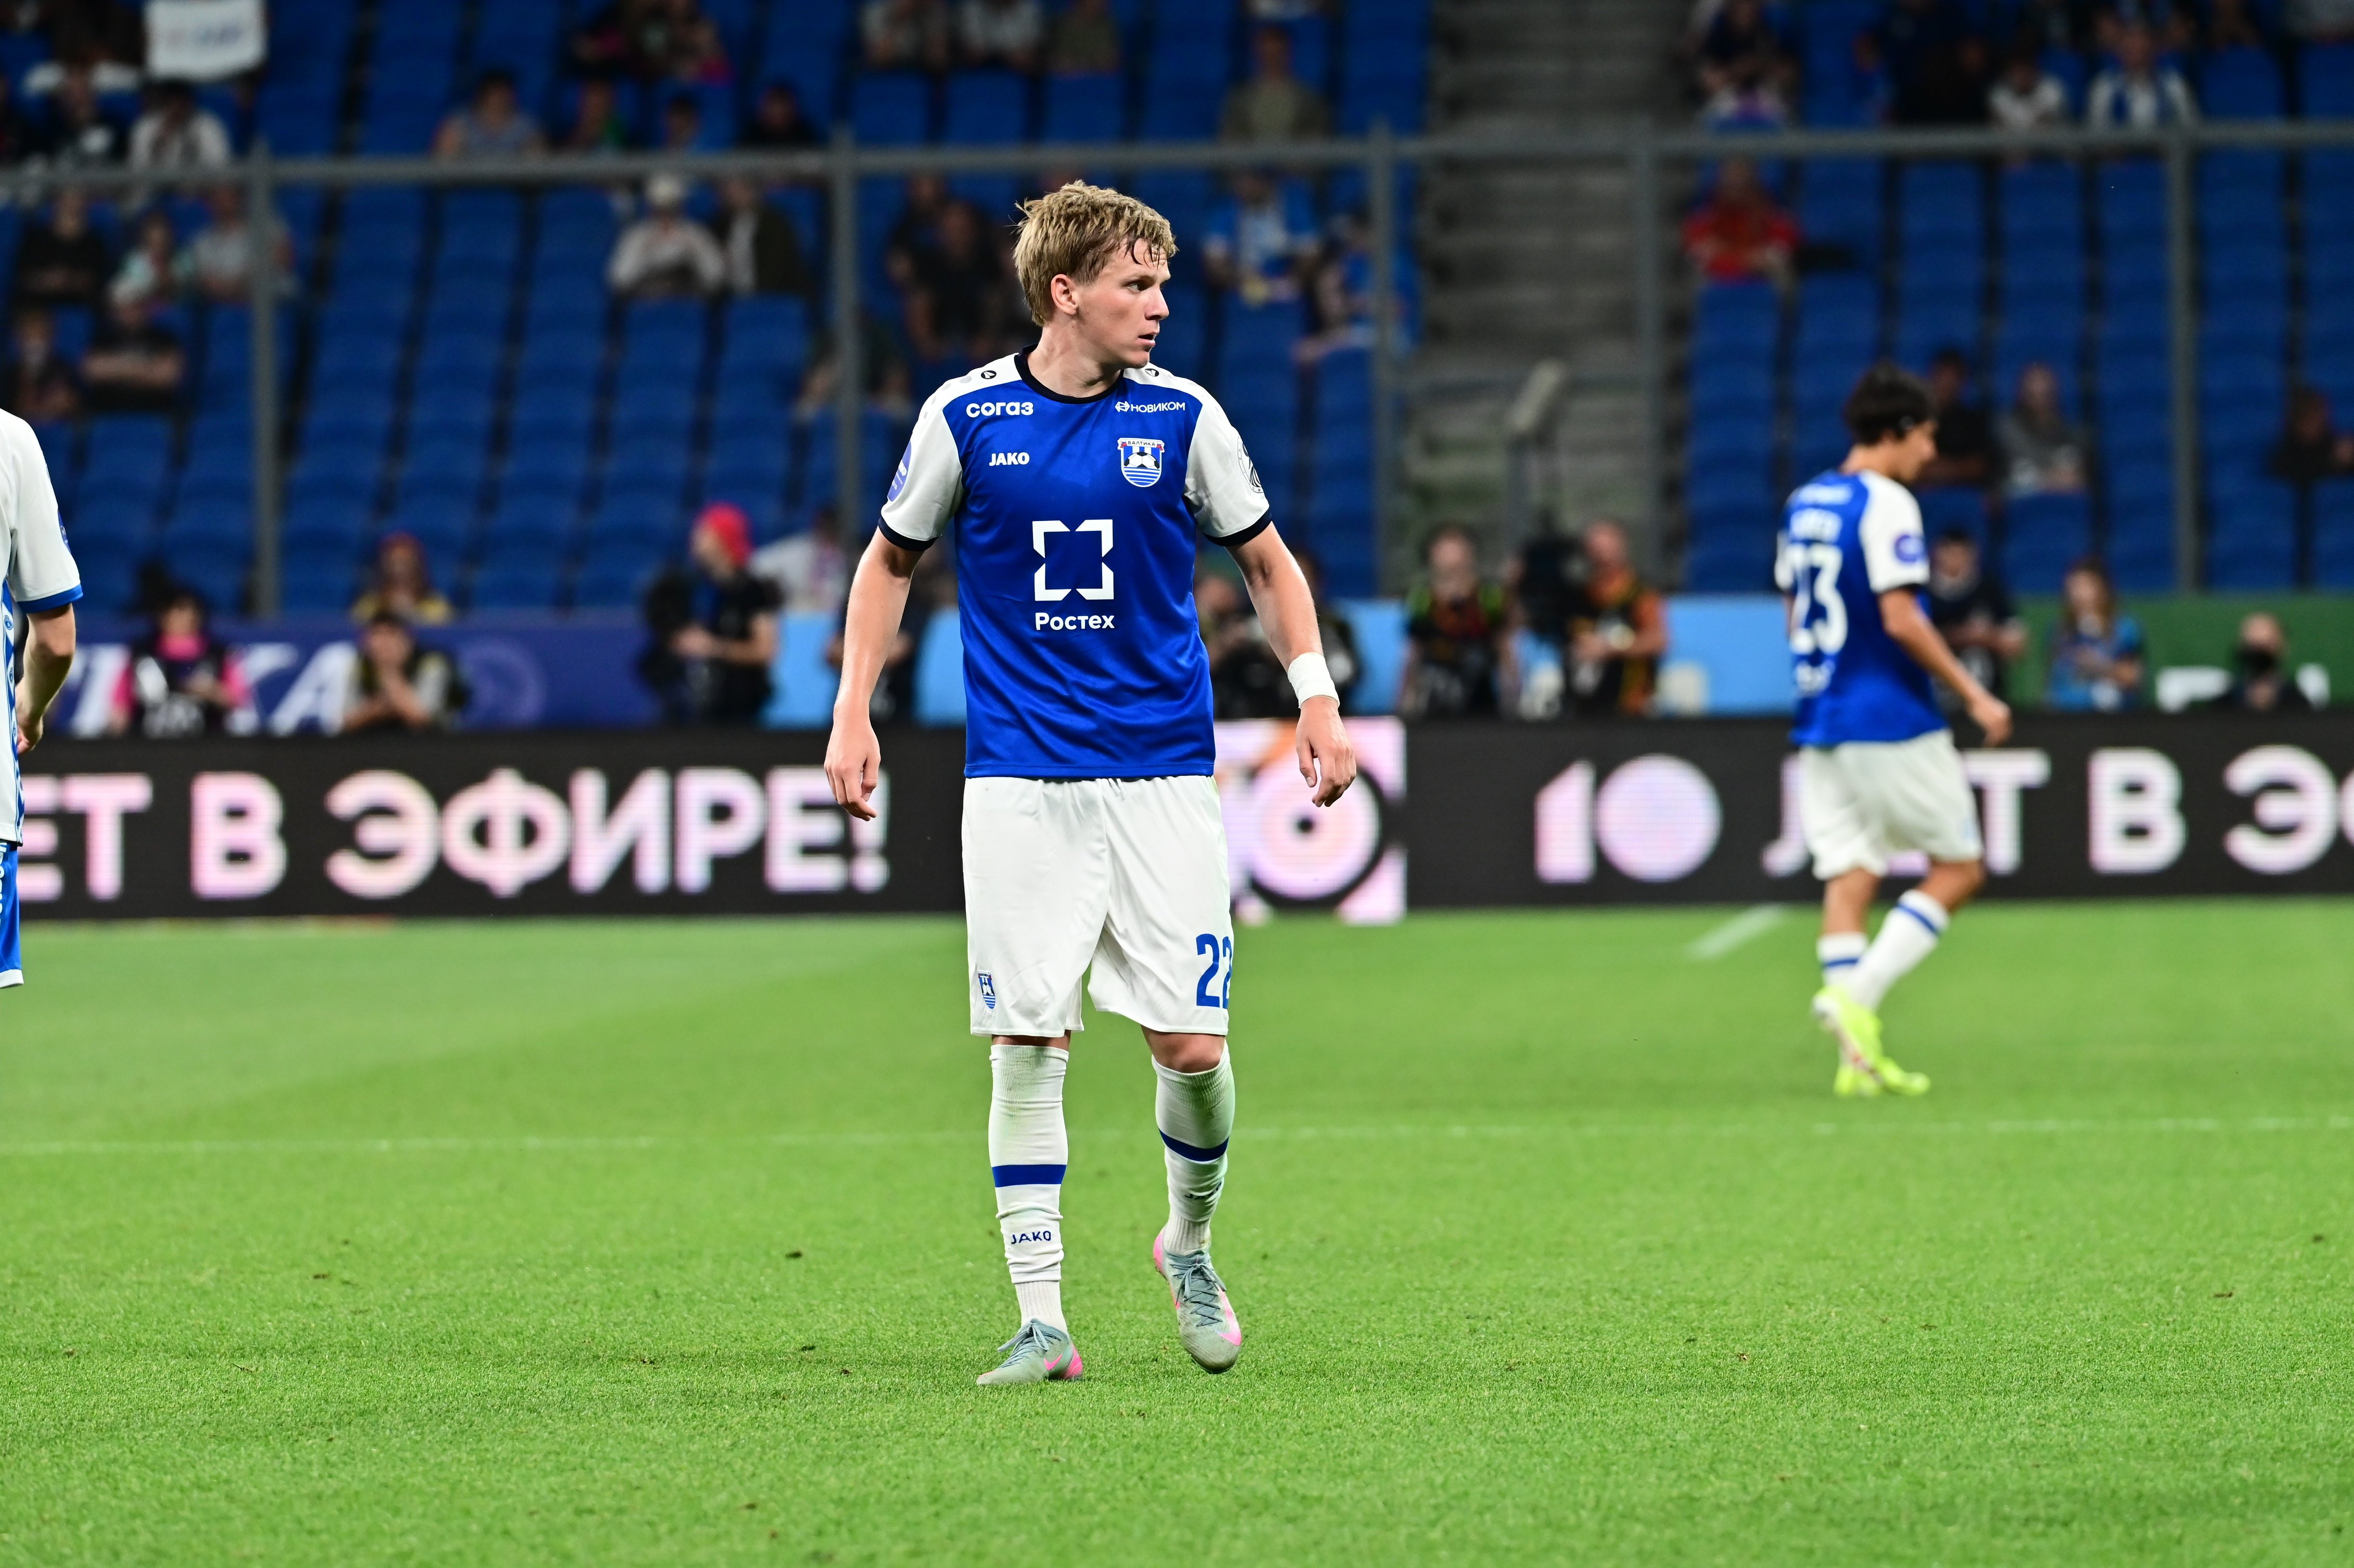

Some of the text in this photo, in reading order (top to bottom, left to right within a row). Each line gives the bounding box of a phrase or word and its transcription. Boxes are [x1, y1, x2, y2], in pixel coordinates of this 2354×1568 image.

[1131, 401, 1186, 413] НОВИКОМ
[989, 452, 1030, 466] JAKO
[1035, 612, 1115, 631] Ростех
[2088, 747, 2188, 876] В
[189, 770, 289, 900] В
[324, 766, 891, 899] ЭФИРЕ!
[1196, 933, 1233, 1010] 22
[1011, 1230, 1051, 1245] JAKO
